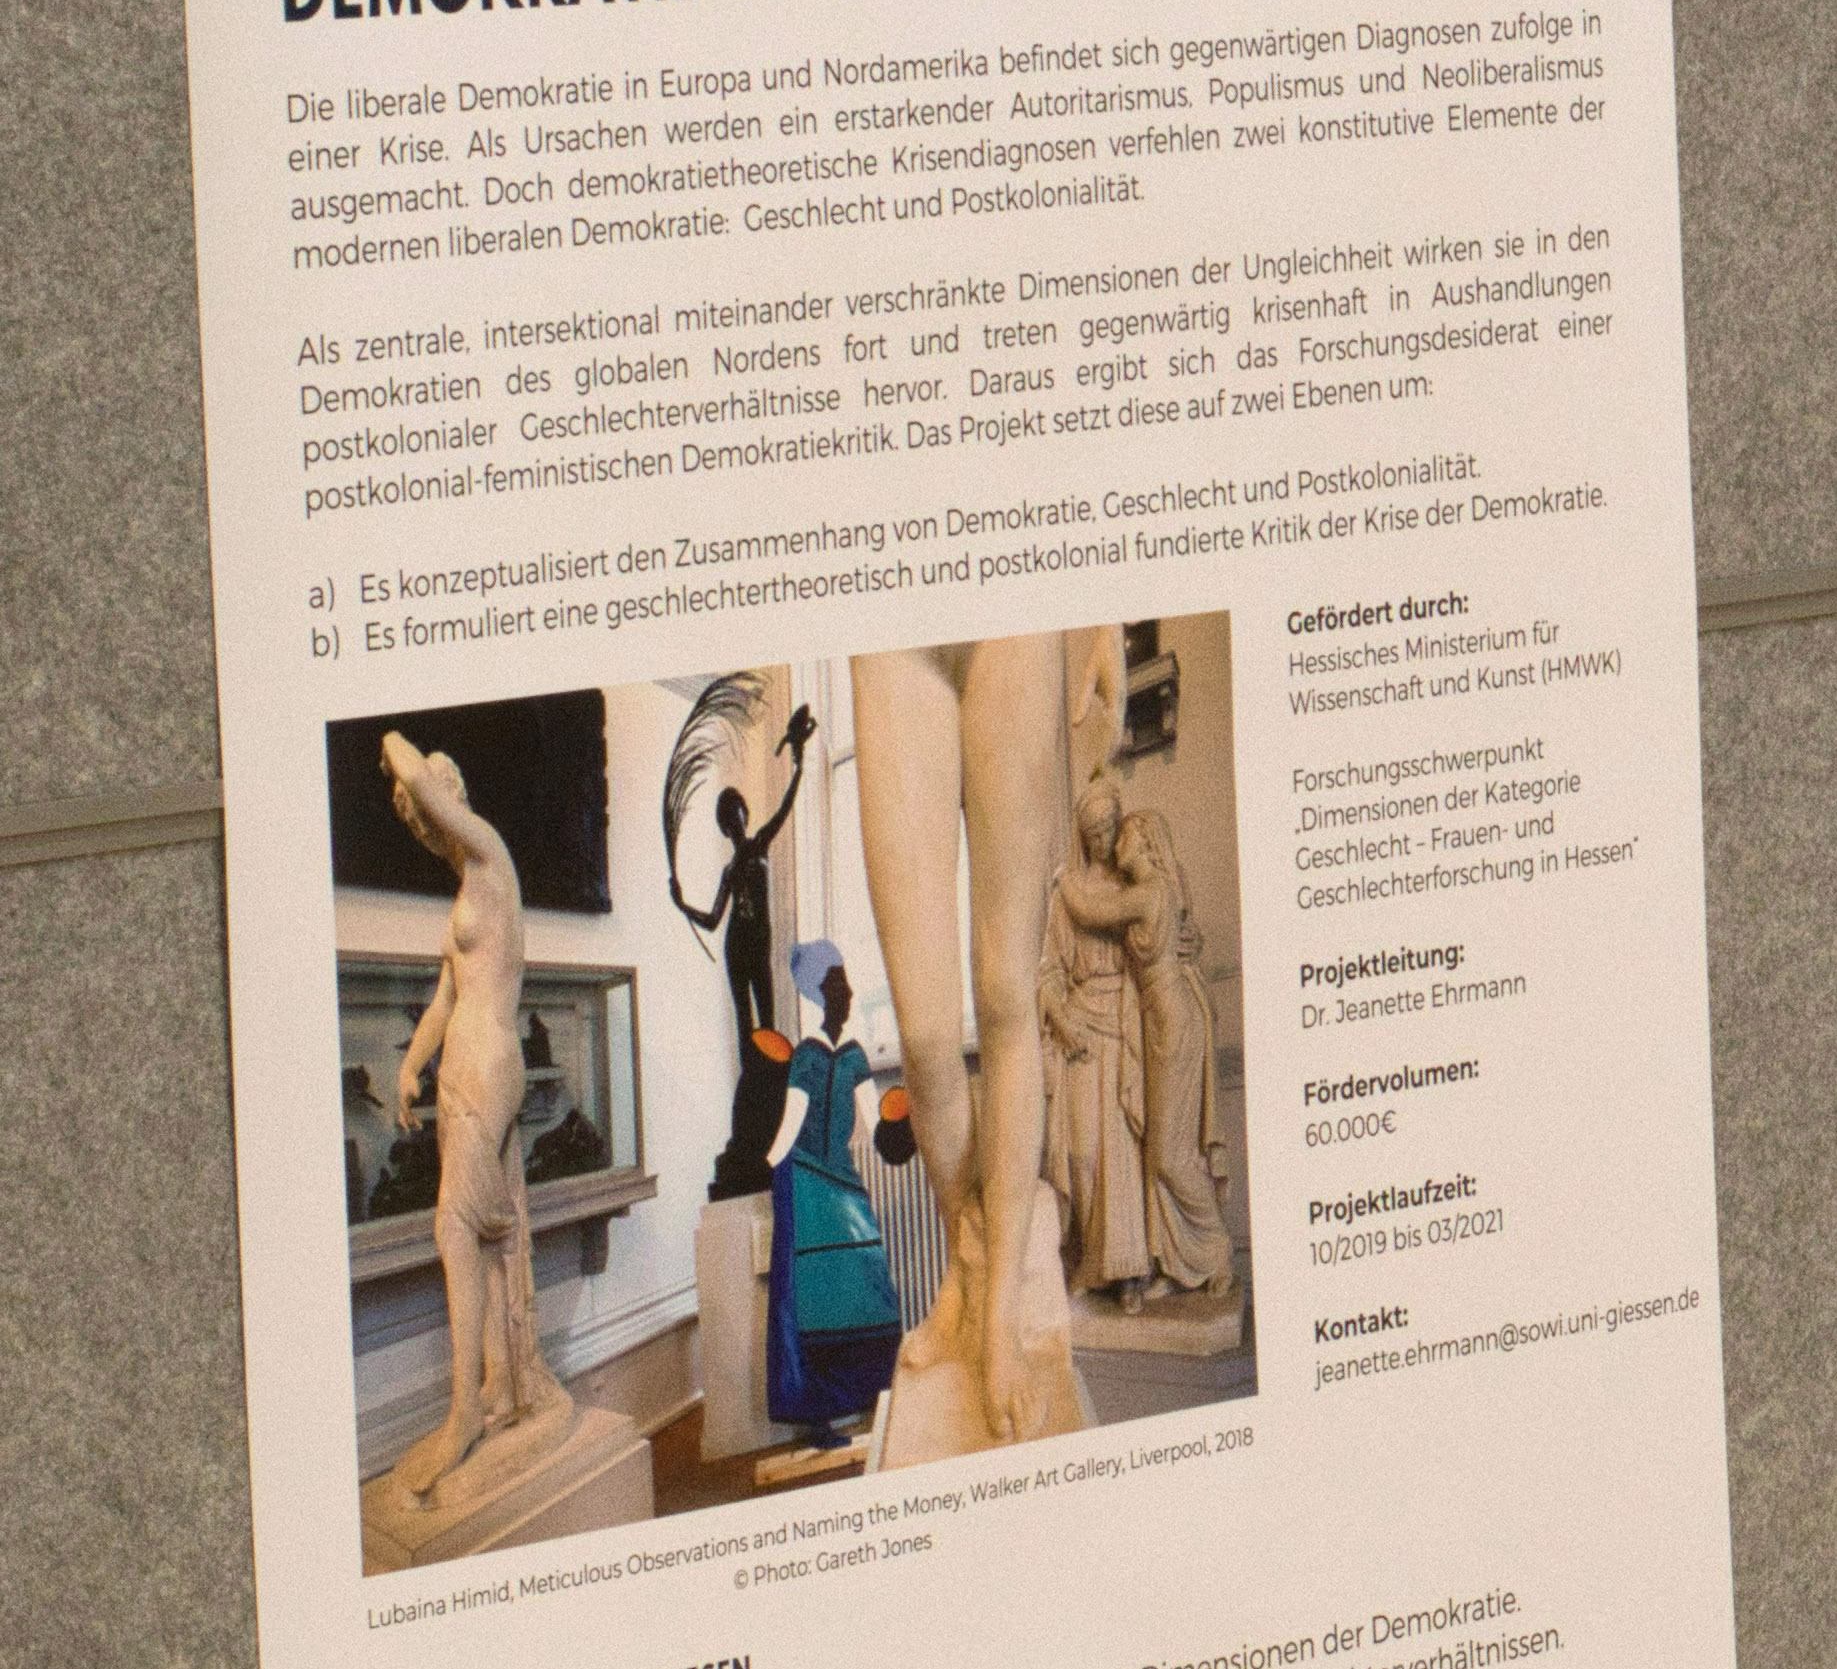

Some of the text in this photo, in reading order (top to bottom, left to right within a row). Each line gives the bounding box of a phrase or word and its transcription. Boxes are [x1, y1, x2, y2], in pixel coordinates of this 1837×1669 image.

[286, 8, 1602, 124] Die liberale Demokratie in Europa und Nordamerika befindet sich gegenwärtigen Diagnosen zufolge in
[1287, 590, 1469, 636] Gefördert durch:
[1300, 944, 1465, 989] Projektleitung:
[1301, 975, 1527, 1030] Dr. Jeanette Ehrmann
[1303, 1059, 1479, 1107] Fördervolumen:
[1309, 1173, 1477, 1226] Projektlaufzeit:
[1309, 1207, 1504, 1266] 10/2019 bis 03/2021
[1314, 1306, 1409, 1344] Kontakt:
[1314, 1288, 1700, 1392] jeanette.ehrmann@sowi.uni-giessen.de
[733, 1533, 933, 1590] © Photo: Gareth Jones
